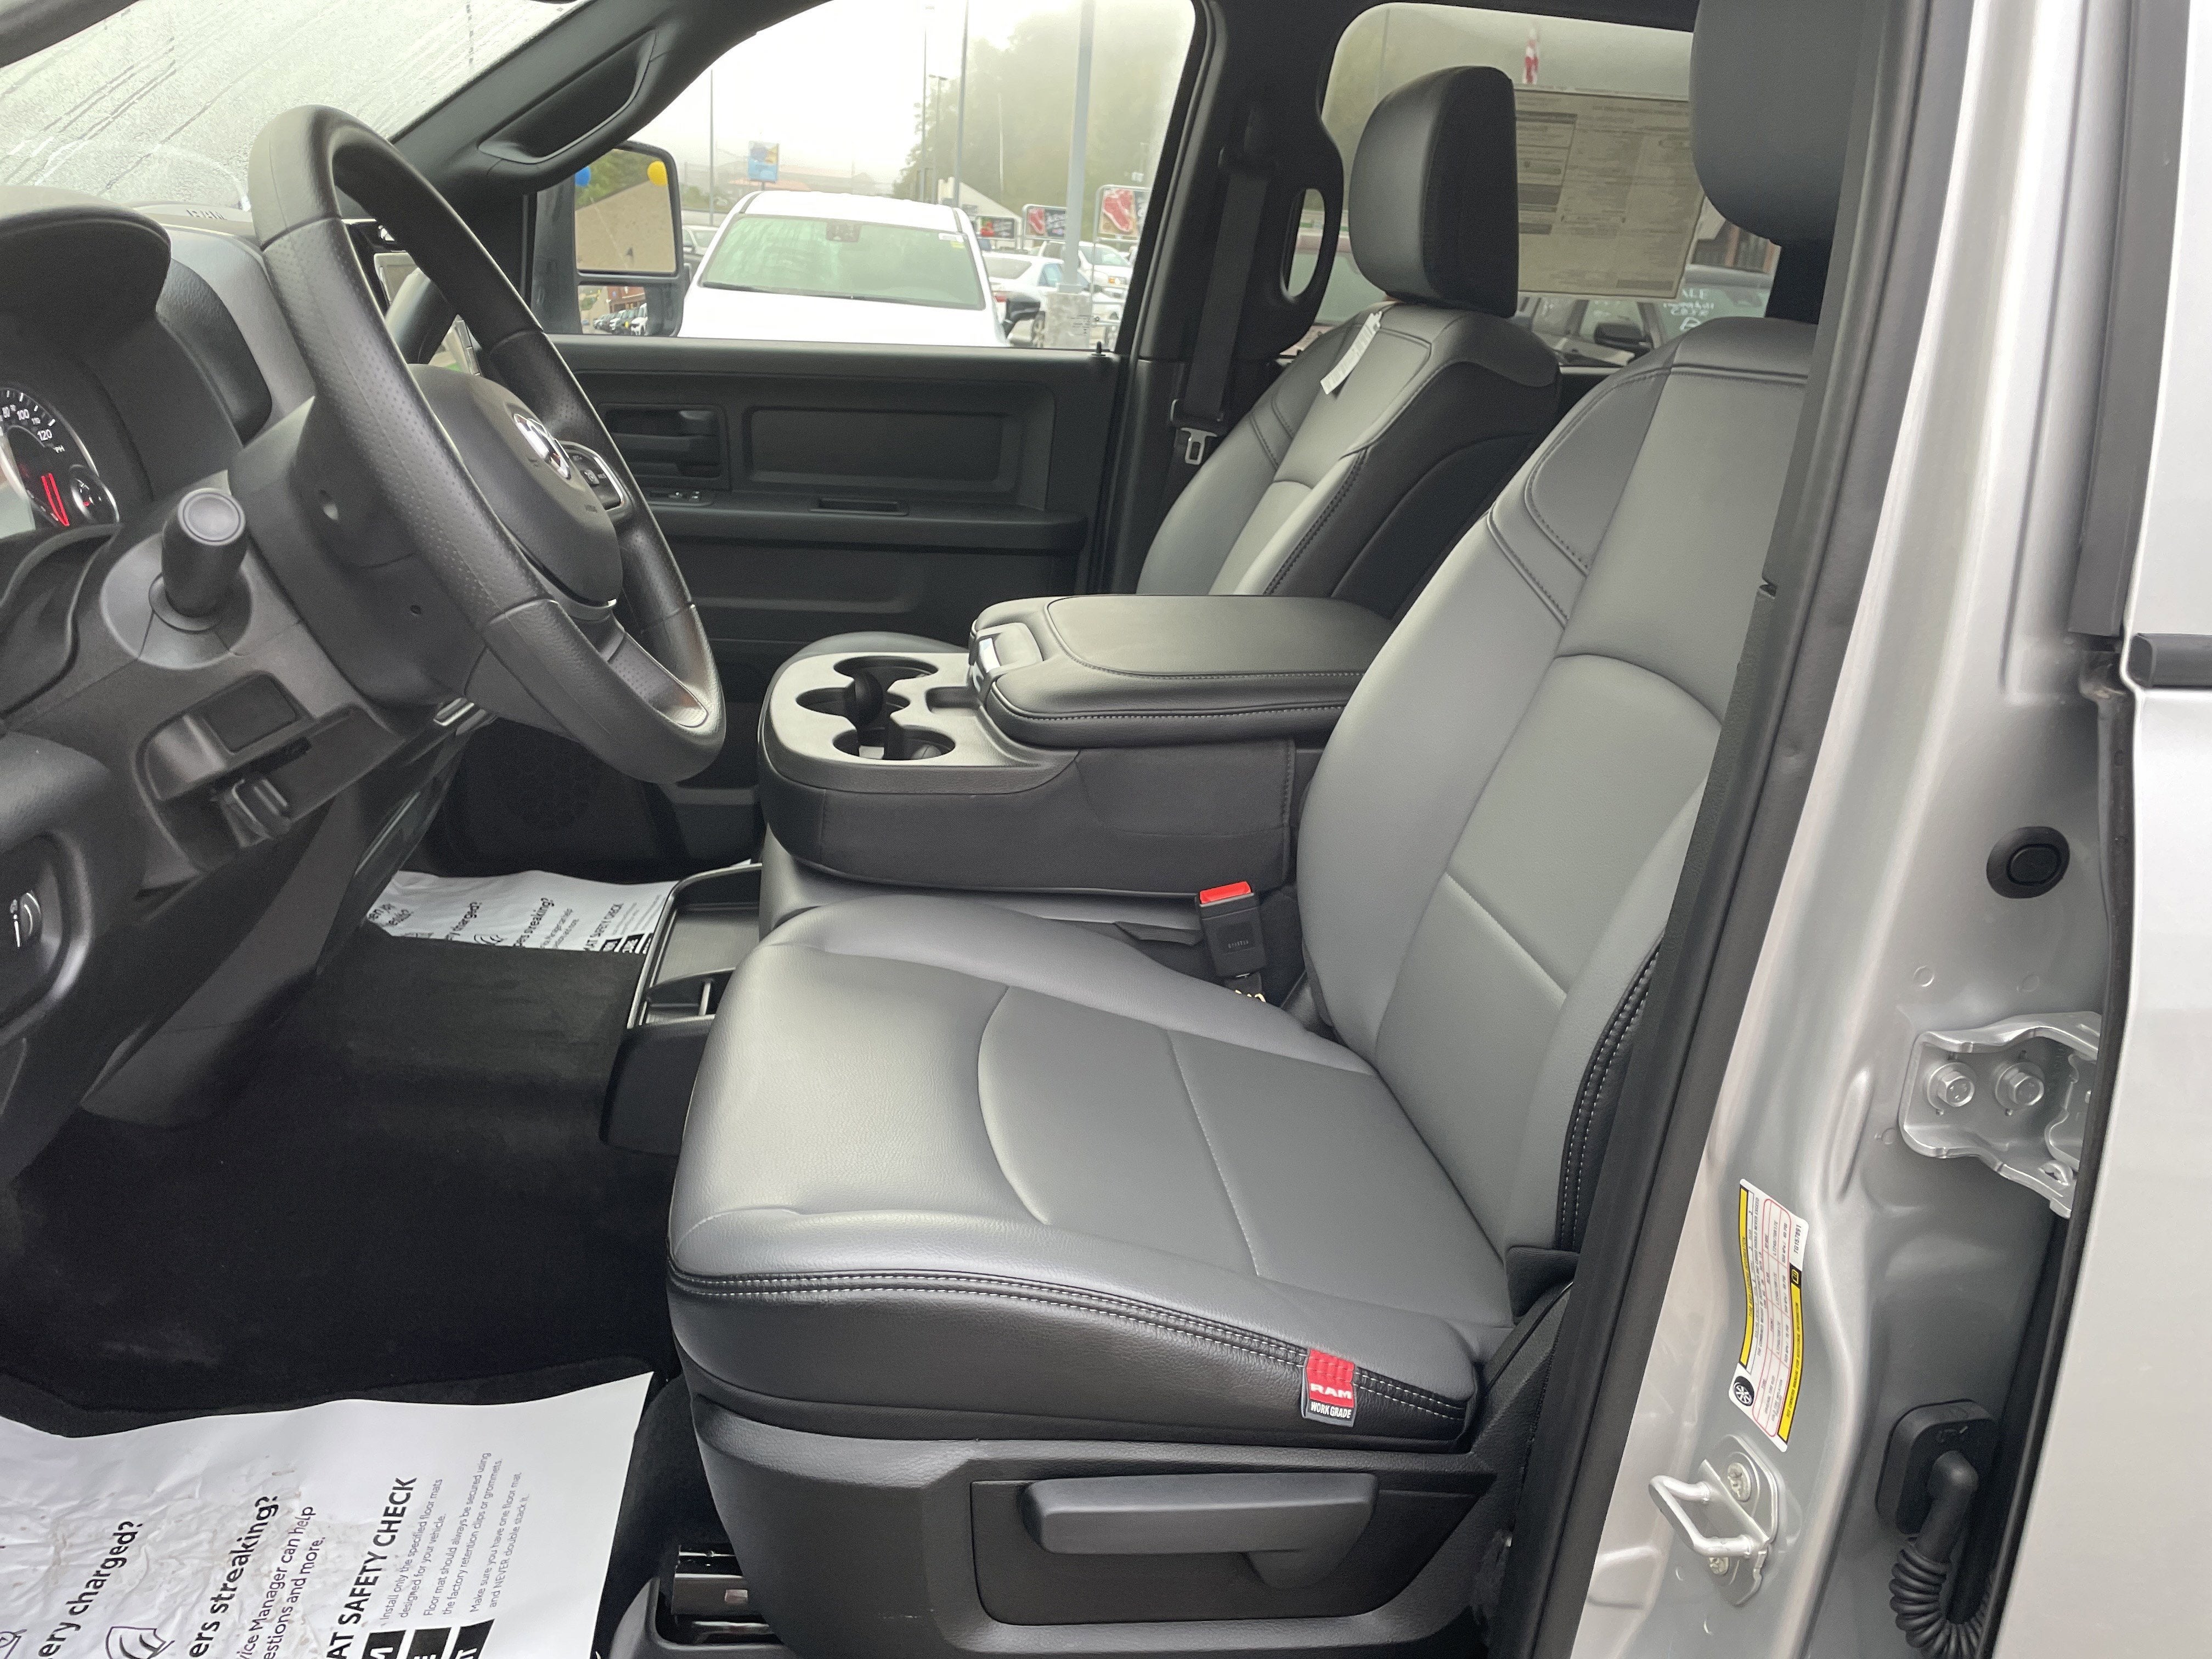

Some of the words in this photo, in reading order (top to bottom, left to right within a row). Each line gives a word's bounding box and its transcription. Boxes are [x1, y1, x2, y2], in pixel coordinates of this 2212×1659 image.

[17, 409, 30, 421] 100
[37, 429, 53, 441] 120
[1310, 1383, 1351, 1399] RAM
[1311, 1401, 1330, 1415] WORK
[1330, 1406, 1352, 1419] GRADE
[477, 1452, 492, 1473] using
[430, 1479, 443, 1499] mats
[466, 1474, 482, 1505] secured
[502, 1489, 516, 1509] floor
[420, 1500, 435, 1520] floor
[459, 1506, 471, 1518] be
[481, 1501, 488, 1509] or
[515, 1503, 527, 1525] stack
[288, 1506, 316, 1534] help
[473, 1510, 486, 1530] clips
[500, 1510, 510, 1526] one
[408, 1521, 427, 1557] specified
[453, 1519, 467, 1545] always
[490, 1528, 504, 1548] have
[505, 1526, 520, 1556] double
[281, 1538, 301, 1564] can
[338, 1551, 387, 1625] SAFETY
[373, 1477, 417, 1547] CHECK
[460, 1531, 479, 1567] retention
[488, 1550, 498, 1565] you
[65, 1521, 143, 1616] charged?
[286, 1578, 307, 1603] and
[300, 1537, 326, 1575] more.
[399, 1559, 413, 1573] the
[400, 1579, 421, 1618] designed
[414, 1565, 427, 1578] for
[422, 1546, 435, 1563] your
[430, 1513, 447, 1543] vehicle.
[440, 1547, 457, 1576] should
[189, 1621, 220, 1658] ers
[210, 1496, 279, 1614] streaking?
[481, 1567, 492, 1586] sure
[493, 1558, 511, 1589] NEVER
[394, 1575, 408, 1593] only
[435, 1577, 446, 1594] mat
[447, 1569, 468, 1600] factory
[249, 1567, 288, 1632] Manager
[380, 1595, 399, 1620] Install
[423, 1596, 439, 1616] Floor
[443, 1600, 455, 1615] the
[470, 1588, 486, 1612] Make
[489, 1590, 501, 1608] and
